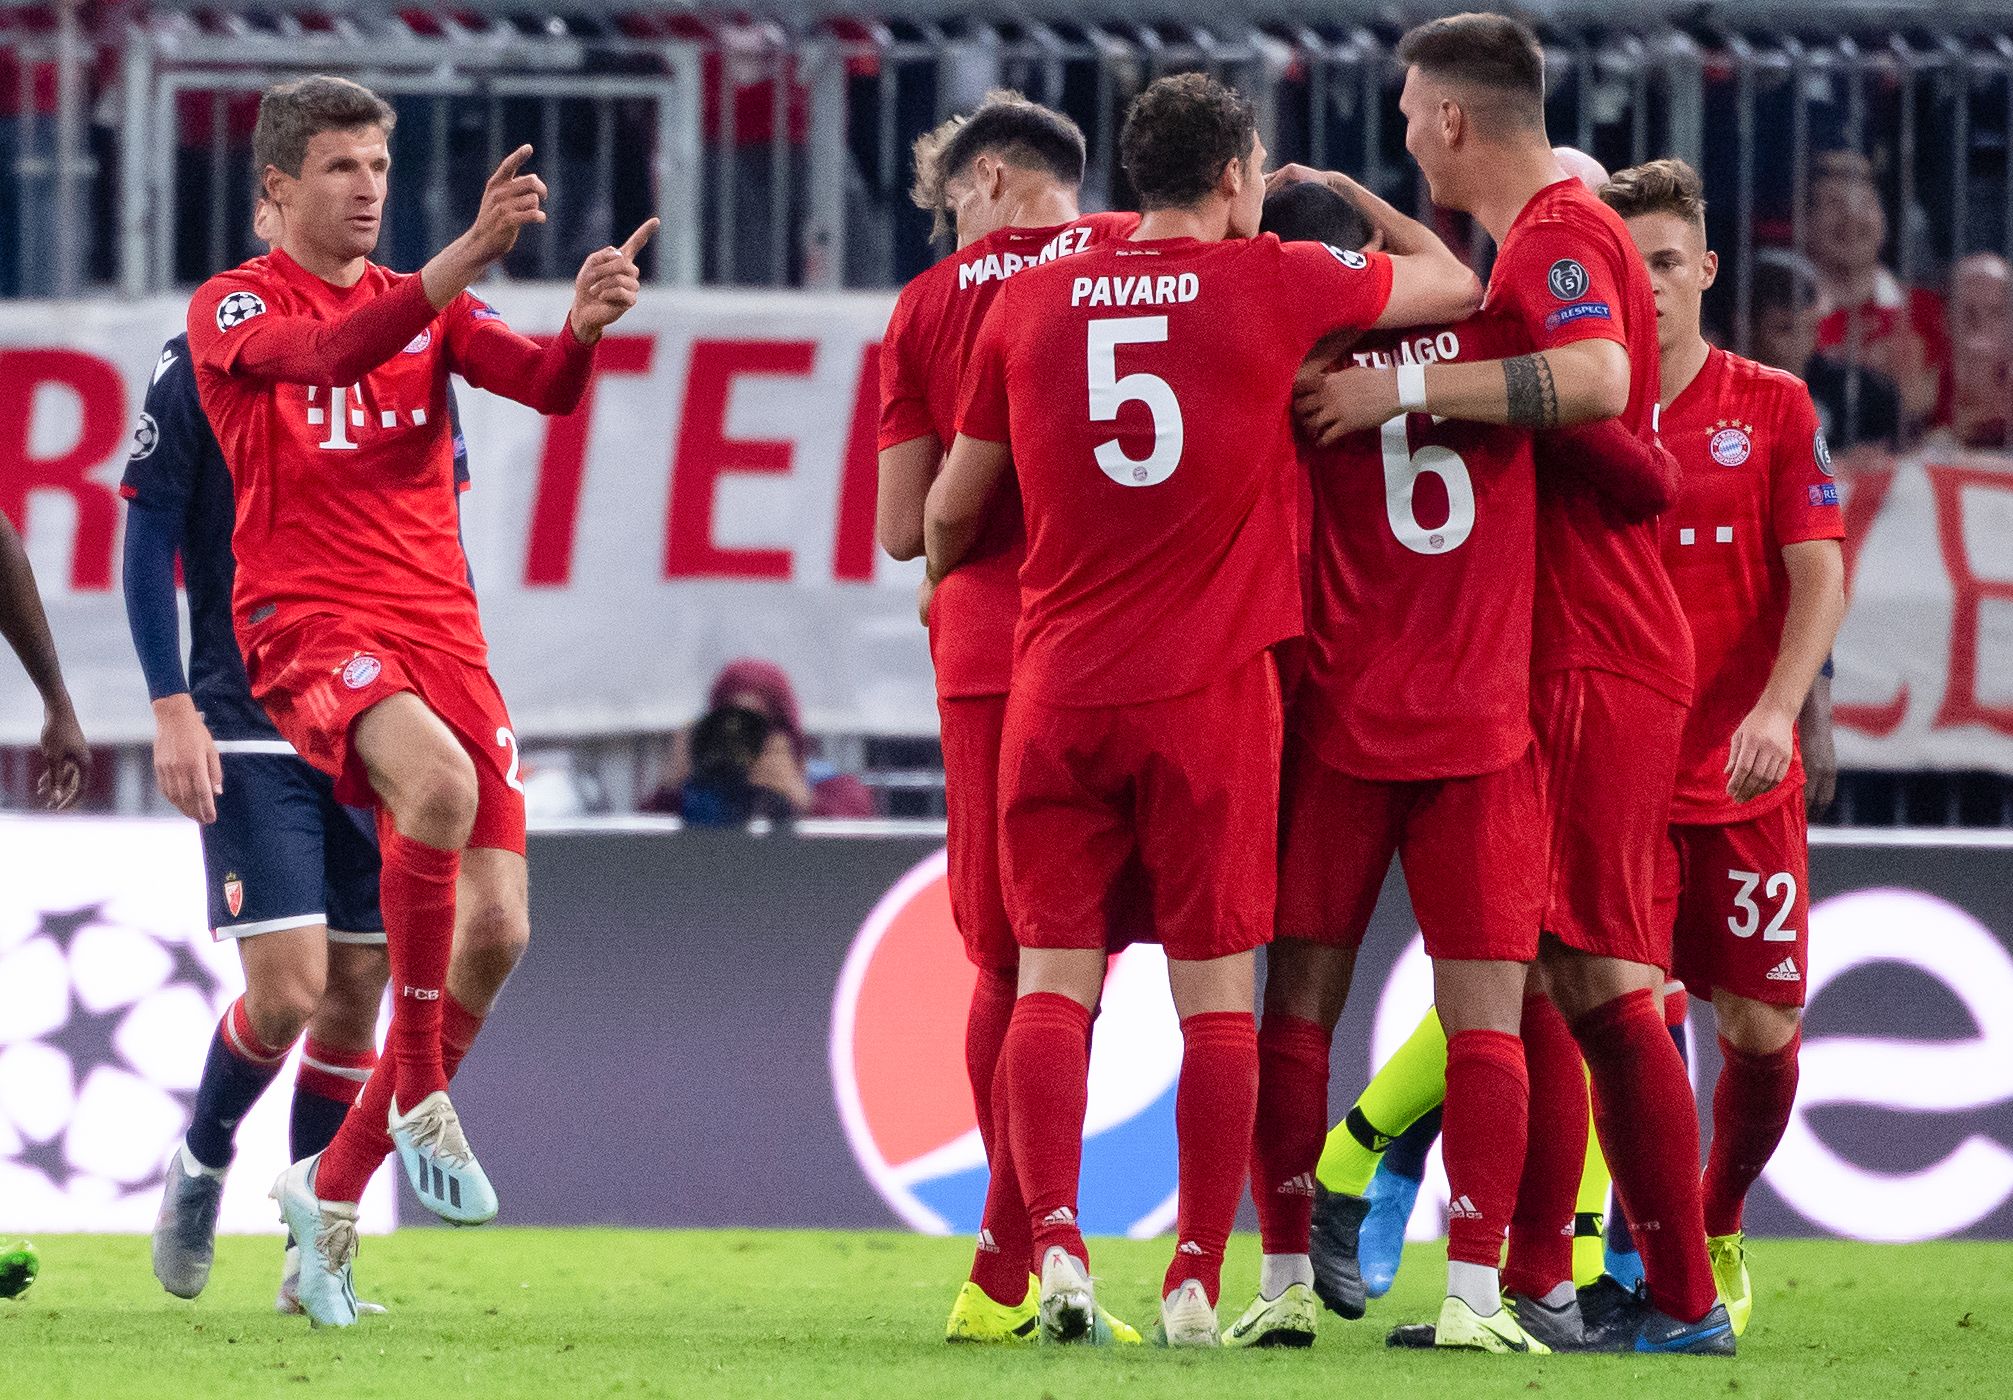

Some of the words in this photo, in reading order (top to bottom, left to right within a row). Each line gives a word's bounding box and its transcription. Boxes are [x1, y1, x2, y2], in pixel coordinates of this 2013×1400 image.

[1071, 272, 1200, 307] PAVARD
[1565, 278, 1575, 290] 5
[1561, 306, 1609, 320] RESPECT
[1088, 315, 1184, 487] 5
[1381, 411, 1475, 555] 6
[496, 726, 525, 796] 2
[1728, 869, 1797, 942] 32
[404, 985, 439, 1000] FCB
